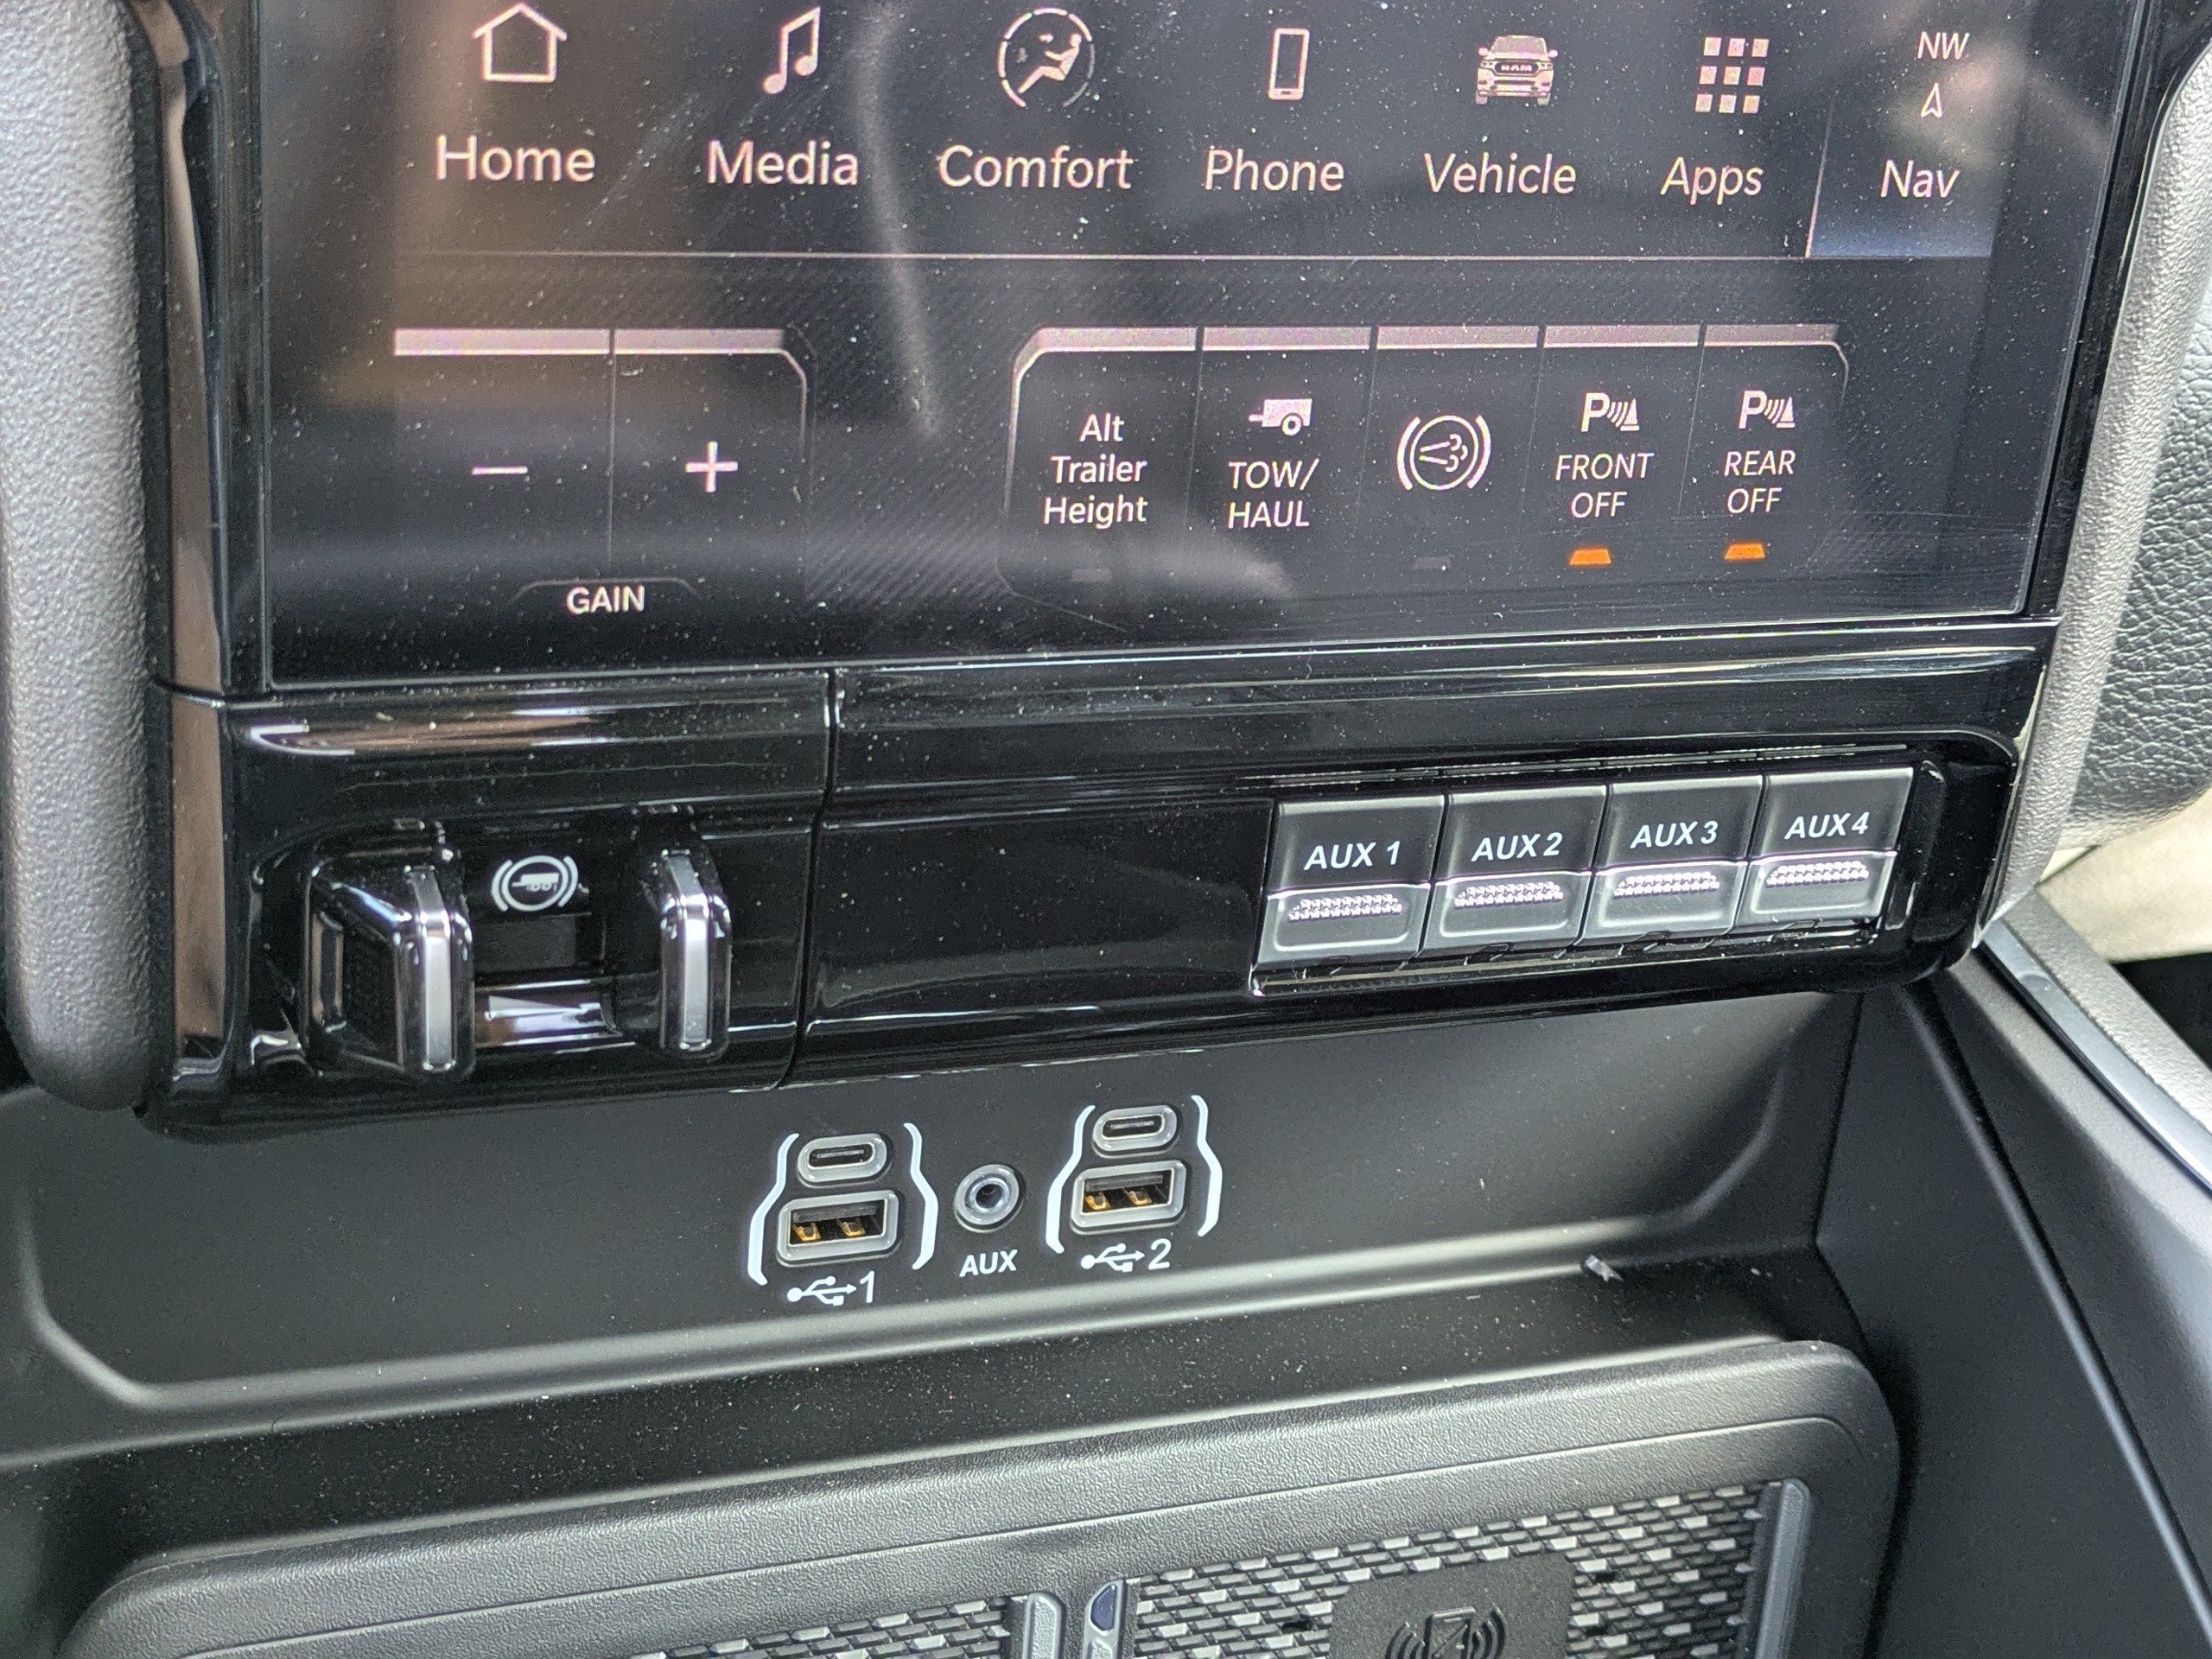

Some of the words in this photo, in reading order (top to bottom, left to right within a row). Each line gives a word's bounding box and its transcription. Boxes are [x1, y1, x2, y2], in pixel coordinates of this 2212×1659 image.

[1916, 30, 1970, 60] NW
[435, 135, 597, 183] Home
[706, 139, 860, 186] Media
[937, 143, 1134, 190] Comfort
[1204, 149, 1344, 193] Phone
[1423, 152, 1578, 196] Vehicle
[1662, 156, 1764, 205] Apps
[1880, 160, 1960, 199] Nav
[1079, 413, 1125, 442] Alt
[1050, 453, 1148, 485] Trailer
[1227, 457, 1320, 491] TOW/
[1555, 452, 1655, 481] FRONT
[1723, 449, 1796, 477] REAR
[1042, 495, 1148, 530] Height
[1227, 499, 1311, 529] HAUL
[1570, 490, 1628, 518] OFF
[1726, 487, 1783, 514] OFF
[566, 585, 645, 615] GAIN
[1630, 823, 1699, 849] AUX
[1700, 820, 1719, 845] 3
[1784, 814, 1849, 841] AUX
[1851, 811, 1871, 836] 4
[1303, 843, 1377, 871] AUX
[1390, 840, 1402, 866] 1
[1471, 835, 1538, 862] AUX
[1542, 832, 1563, 857] 2
[959, 1249, 1018, 1278] AUX
[1147, 1237, 1173, 1270] 2
[858, 1270, 875, 1303] 1
